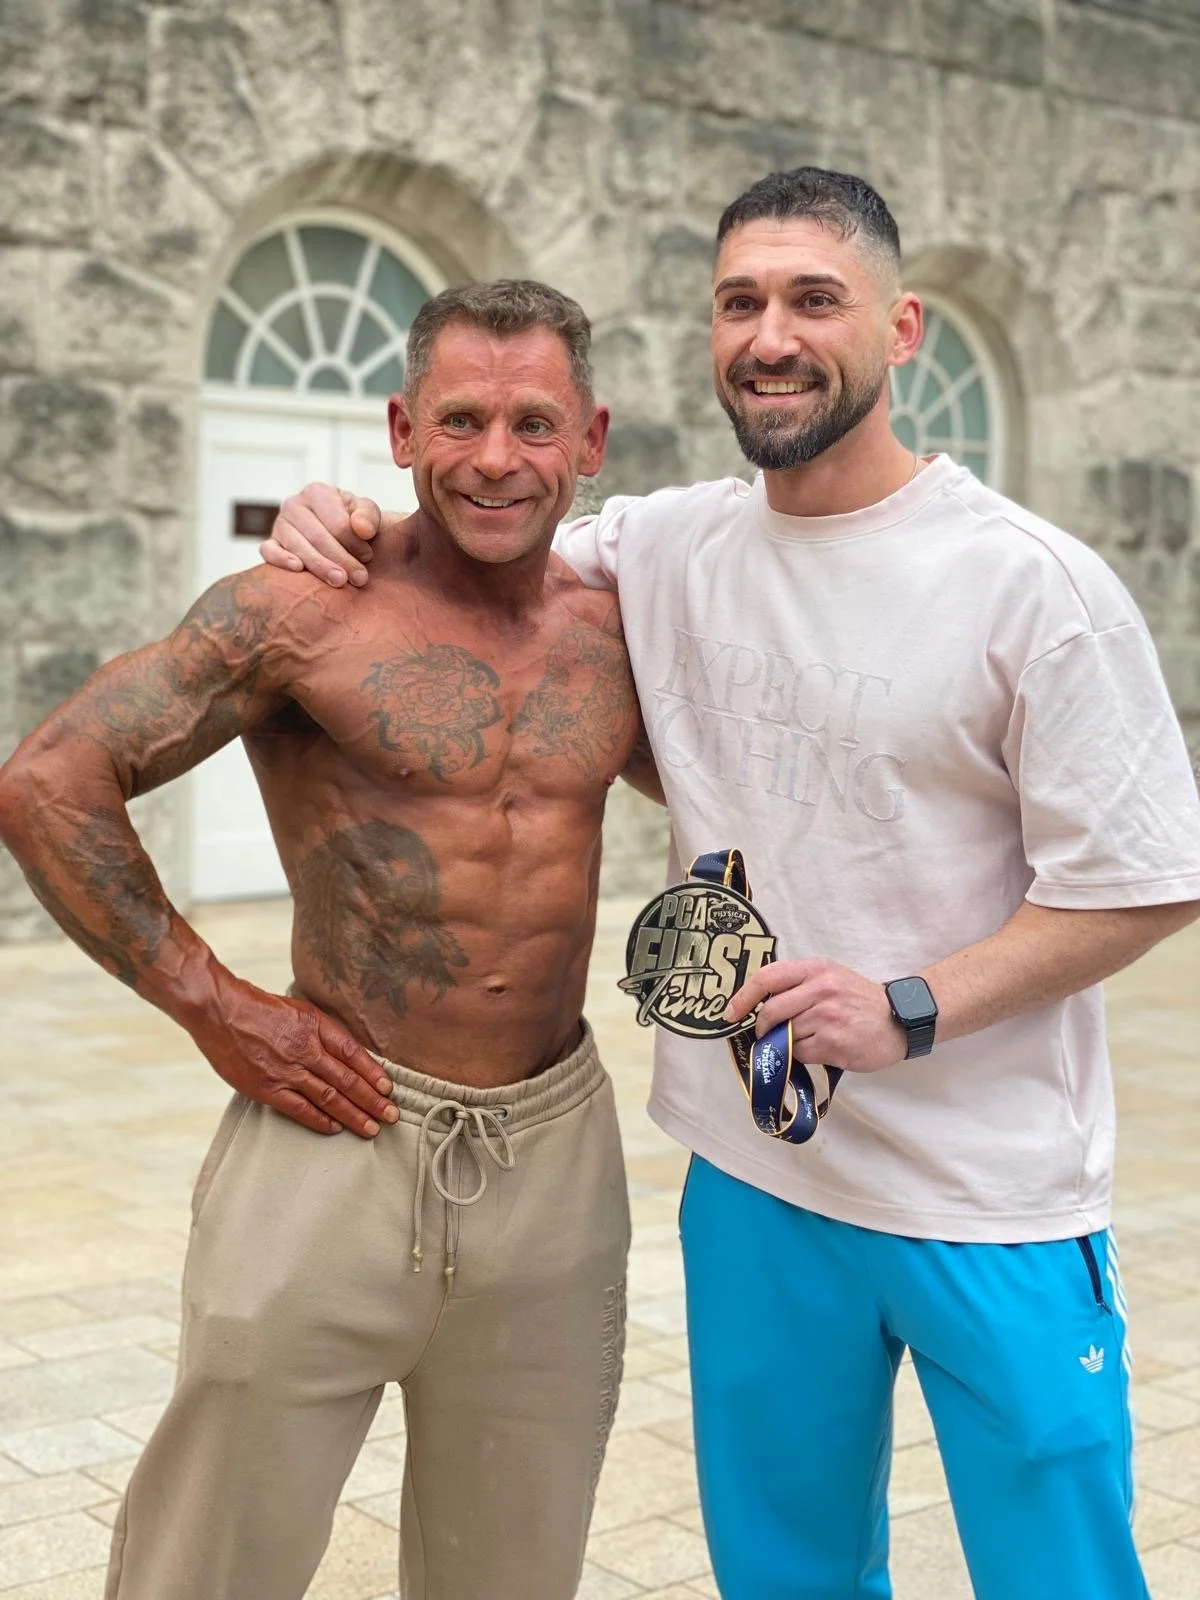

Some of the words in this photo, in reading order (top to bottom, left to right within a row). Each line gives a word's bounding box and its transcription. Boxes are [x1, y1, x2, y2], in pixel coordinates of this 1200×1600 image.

[652, 696, 908, 822] OTHING
[658, 894, 709, 930] PCA
[712, 909, 747, 920] PHYSICAL
[629, 926, 776, 999] FIRST
[617, 966, 757, 1027] Time
[761, 1043, 772, 1085] PHYSICAL
